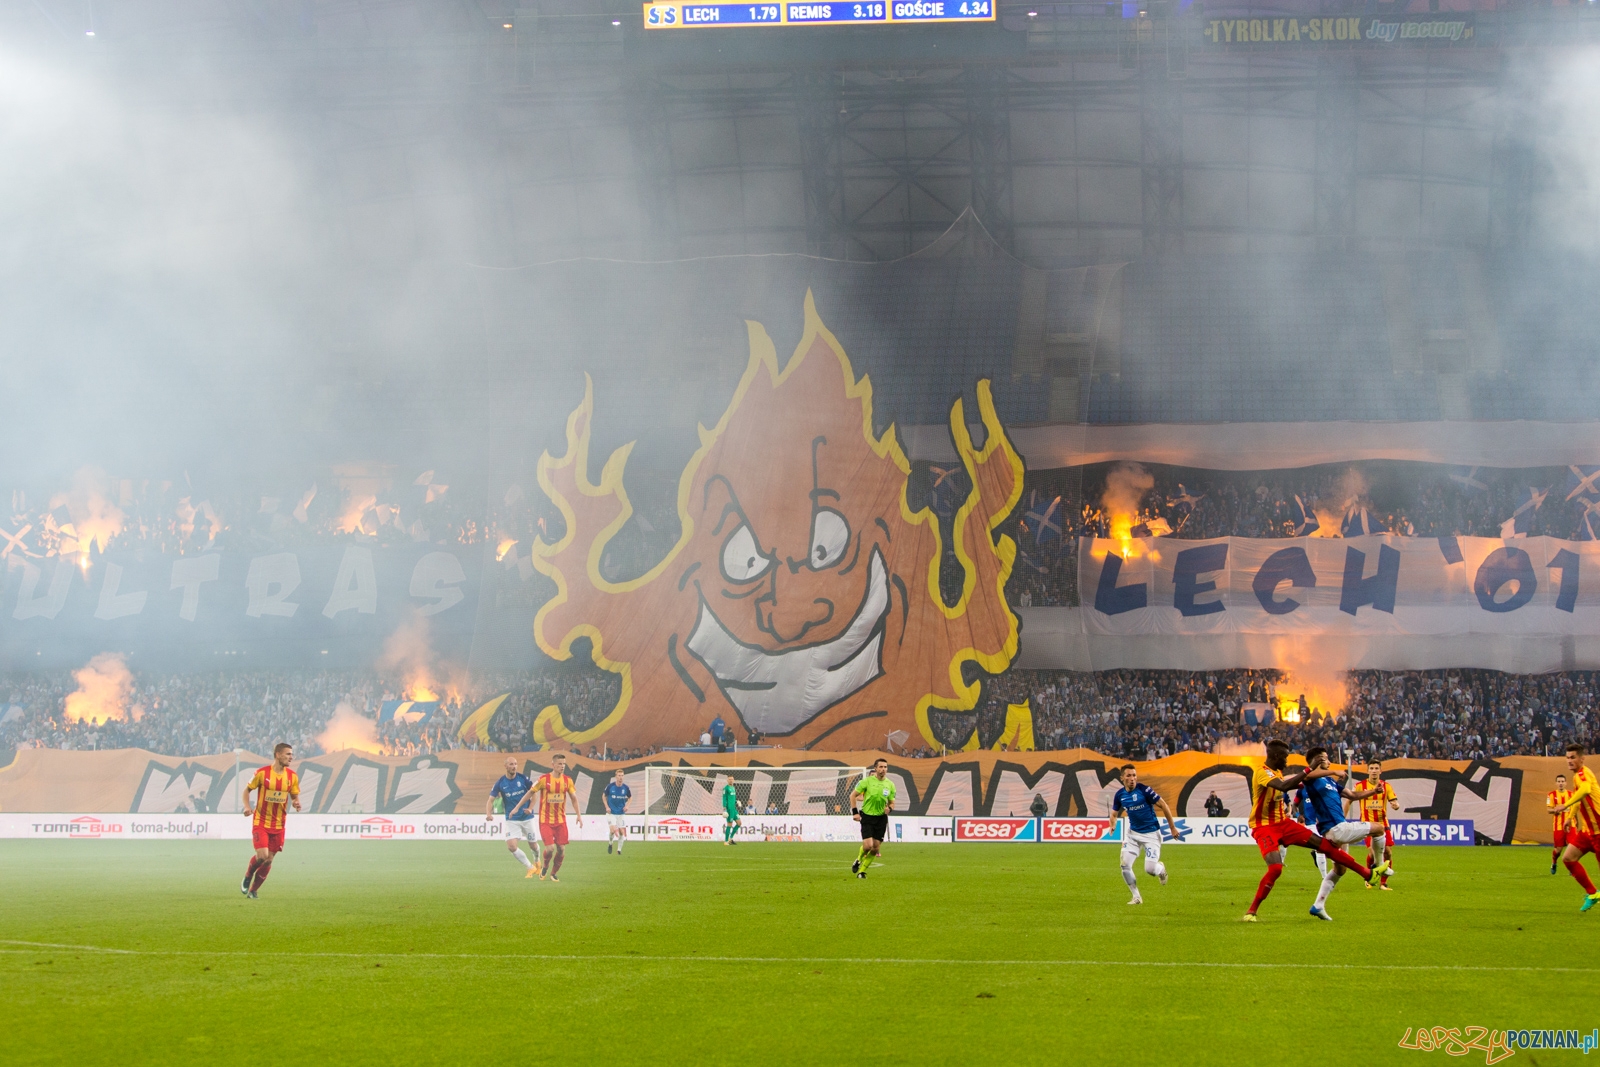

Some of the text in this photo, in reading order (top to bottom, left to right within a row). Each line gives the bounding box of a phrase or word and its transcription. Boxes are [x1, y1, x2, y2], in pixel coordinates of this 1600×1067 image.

[648, 6, 677, 26] STS
[685, 6, 777, 21] LECH 1.79
[790, 4, 883, 19] REMIS 3.18
[895, 1, 989, 16] GOŚCIE 4.34
[1366, 19, 1399, 42] Joy
[7, 546, 467, 622] ULTRAS
[1094, 542, 1400, 616] LECH
[32, 821, 208, 836] TOMA-BUD toma-bud.pl
[321, 822, 502, 837] TOMA-BUD toma-bud.pl
[961, 820, 1011, 837] tesa
[1047, 821, 1098, 837] tesa
